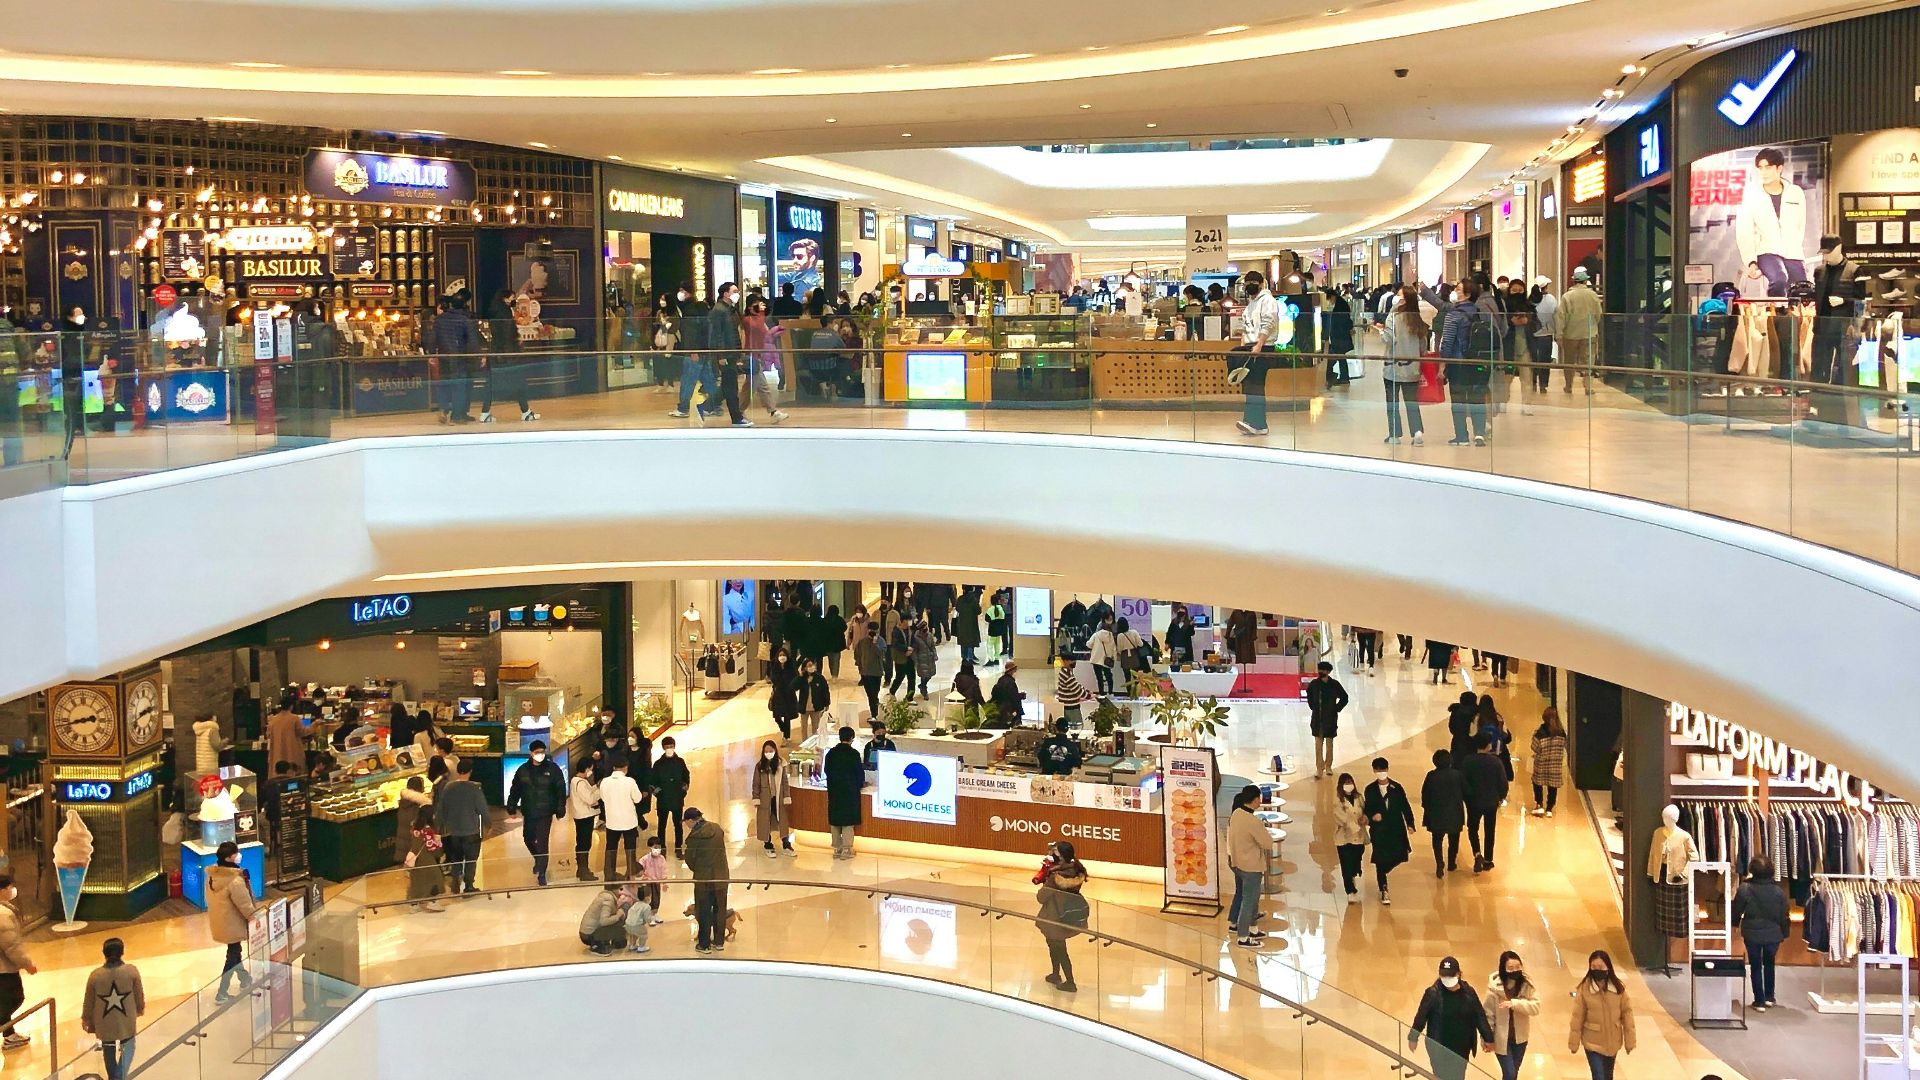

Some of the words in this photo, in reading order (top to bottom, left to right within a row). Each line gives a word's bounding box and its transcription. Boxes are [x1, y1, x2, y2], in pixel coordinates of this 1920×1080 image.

[1872, 153, 1904, 164] FIND
[1909, 153, 1919, 164] A
[376, 161, 448, 188] BASILUR
[392, 188, 405, 197] Tea
[414, 189, 437, 199] Coffee
[789, 206, 823, 232] GUESS
[1194, 229, 1222, 243] 2021
[243, 259, 324, 277] BASILUR
[354, 595, 412, 621] LeTAO
[1670, 701, 1788, 777] PLATFORM
[1789, 748, 1876, 814] PLACE
[68, 783, 111, 799] LeTAO
[976, 779, 995, 788] CREAM
[996, 780, 1017, 790] CHEESE
[884, 799, 913, 810] MONO
[914, 802, 952, 815] CHEESE
[1005, 818, 1051, 835] MONO
[1060, 823, 1122, 841] CHEESE
